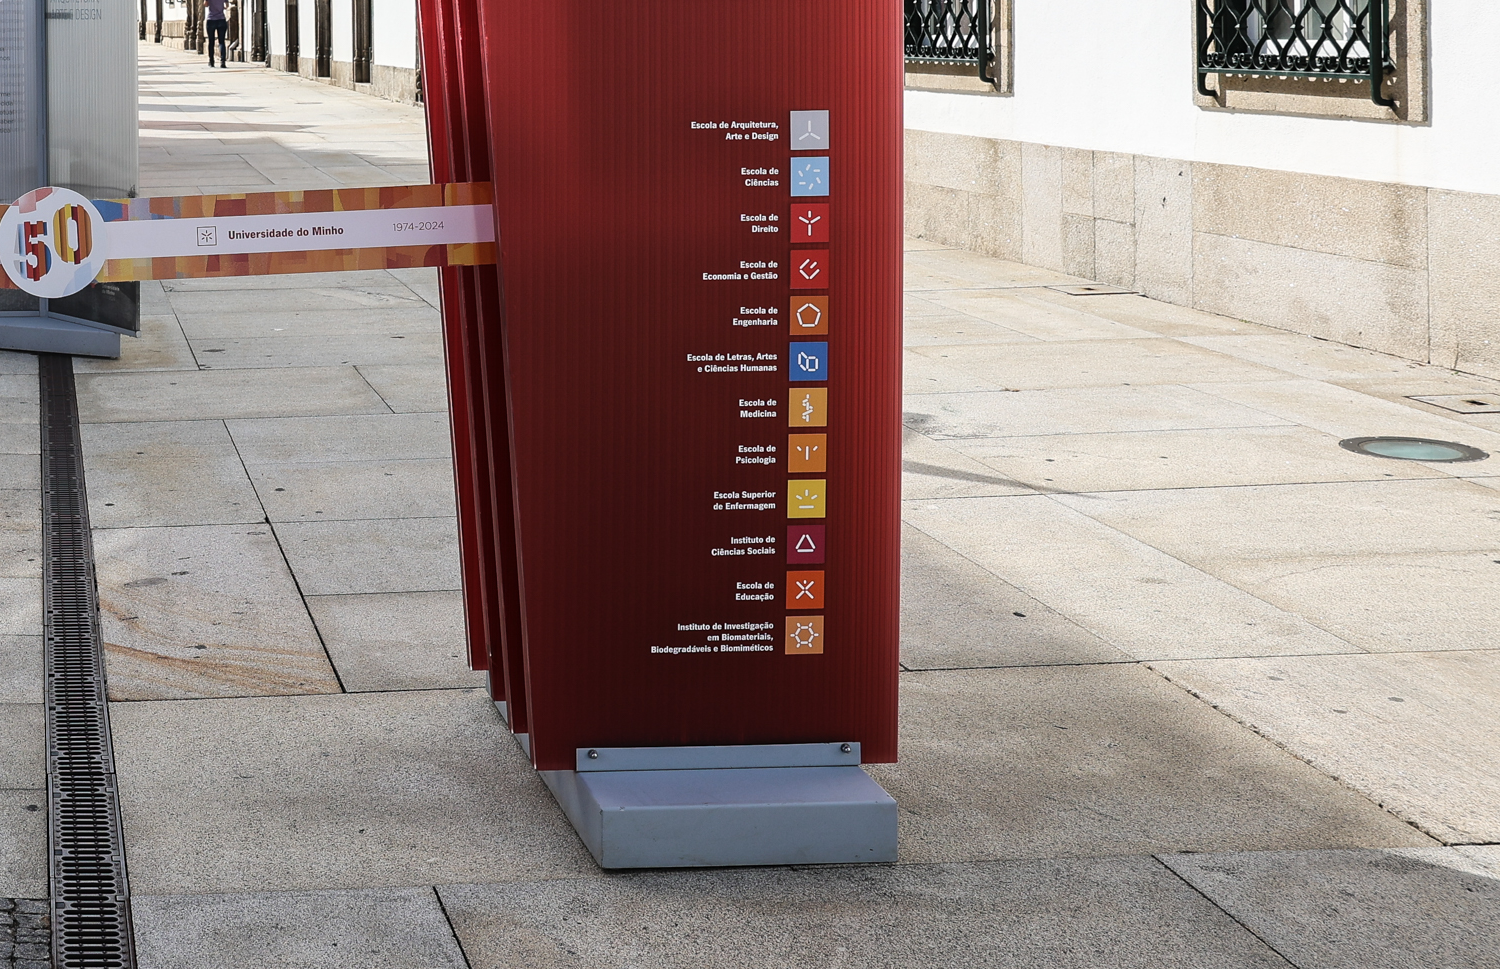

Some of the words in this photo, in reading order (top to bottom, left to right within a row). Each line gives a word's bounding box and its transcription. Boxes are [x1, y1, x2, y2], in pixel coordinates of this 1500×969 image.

[690, 121, 717, 129] Escola
[718, 121, 729, 129] de
[730, 120, 778, 130] Arquitetura,
[725, 132, 742, 140] Arte
[751, 131, 778, 141] Design
[741, 167, 767, 175] Escola
[768, 167, 779, 175] de
[744, 178, 779, 186] Ciências
[740, 213, 766, 222] Escola
[768, 213, 778, 221] de
[392, 220, 444, 232] 1974-2024
[751, 224, 778, 233] Direito
[228, 228, 293, 240] Universidade
[296, 227, 309, 236] do
[312, 225, 343, 236] Minho
[14, 203, 93, 282] 50
[740, 260, 766, 268] Escola
[767, 260, 778, 268] de
[702, 272, 741, 280] Economia
[750, 271, 778, 280] Gestão
[740, 306, 766, 314] Escola
[767, 306, 778, 314] de
[732, 317, 777, 327] Engenharia
[686, 353, 713, 361] Escola
[714, 353, 725, 361] de
[726, 353, 754, 361] Letras,
[756, 352, 777, 360] Artes
[704, 364, 738, 372] Ciências
[740, 364, 777, 372] Humanas
[713, 491, 739, 499] Escola
[741, 490, 776, 500] Superior
[712, 502, 723, 510] de
[725, 501, 775, 511] Enfermagem
[730, 536, 764, 544] Instituto
[765, 535, 775, 543] de
[711, 547, 745, 556] Ciências
[747, 546, 775, 555] Sociais
[736, 581, 762, 589] Escola
[764, 581, 774, 589] de
[735, 592, 774, 602] Educação
[677, 622, 710, 631] Instituto
[711, 622, 722, 630] de
[724, 621, 774, 631] Investigação
[721, 632, 773, 641] Biomateriais,
[650, 644, 711, 654] Biodegradáveis
[720, 643, 773, 652] Biomiméticos
